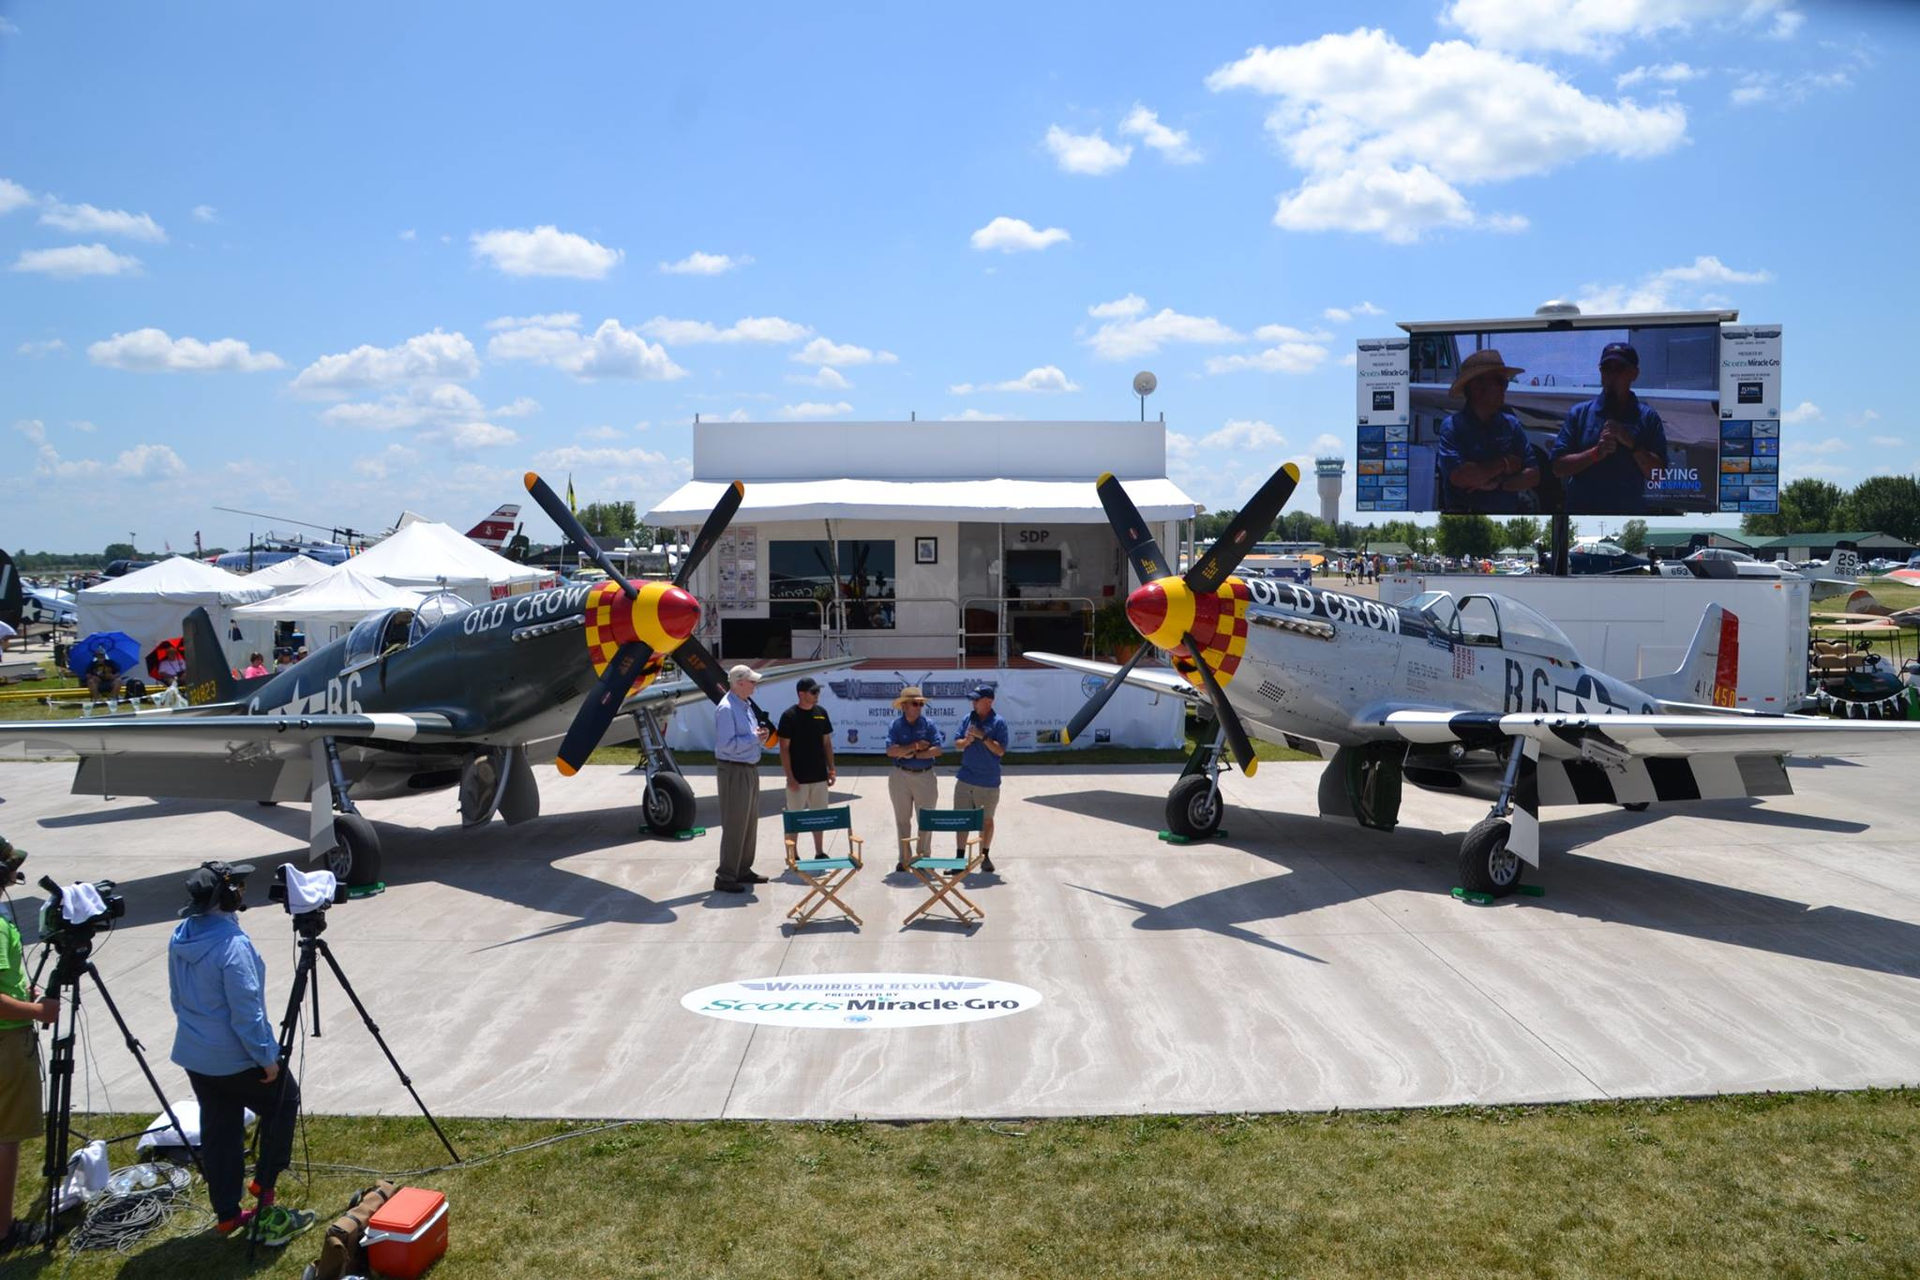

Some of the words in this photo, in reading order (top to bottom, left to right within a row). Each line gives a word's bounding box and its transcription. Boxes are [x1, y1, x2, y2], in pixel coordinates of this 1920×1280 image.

[1651, 468, 1698, 480] FLYING
[1019, 530, 1050, 543] SDP
[1837, 553, 1856, 567] 2S
[1670, 567, 1688, 576] 653
[463, 602, 508, 636] OLD
[513, 584, 593, 623] CROW
[1245, 578, 1316, 614] OLD
[1320, 591, 1401, 634] CROW
[1503, 657, 1550, 714] B6
[327, 671, 363, 715] B6
[865, 982, 885, 991] IN
[701, 999, 844, 1012] Scotts
